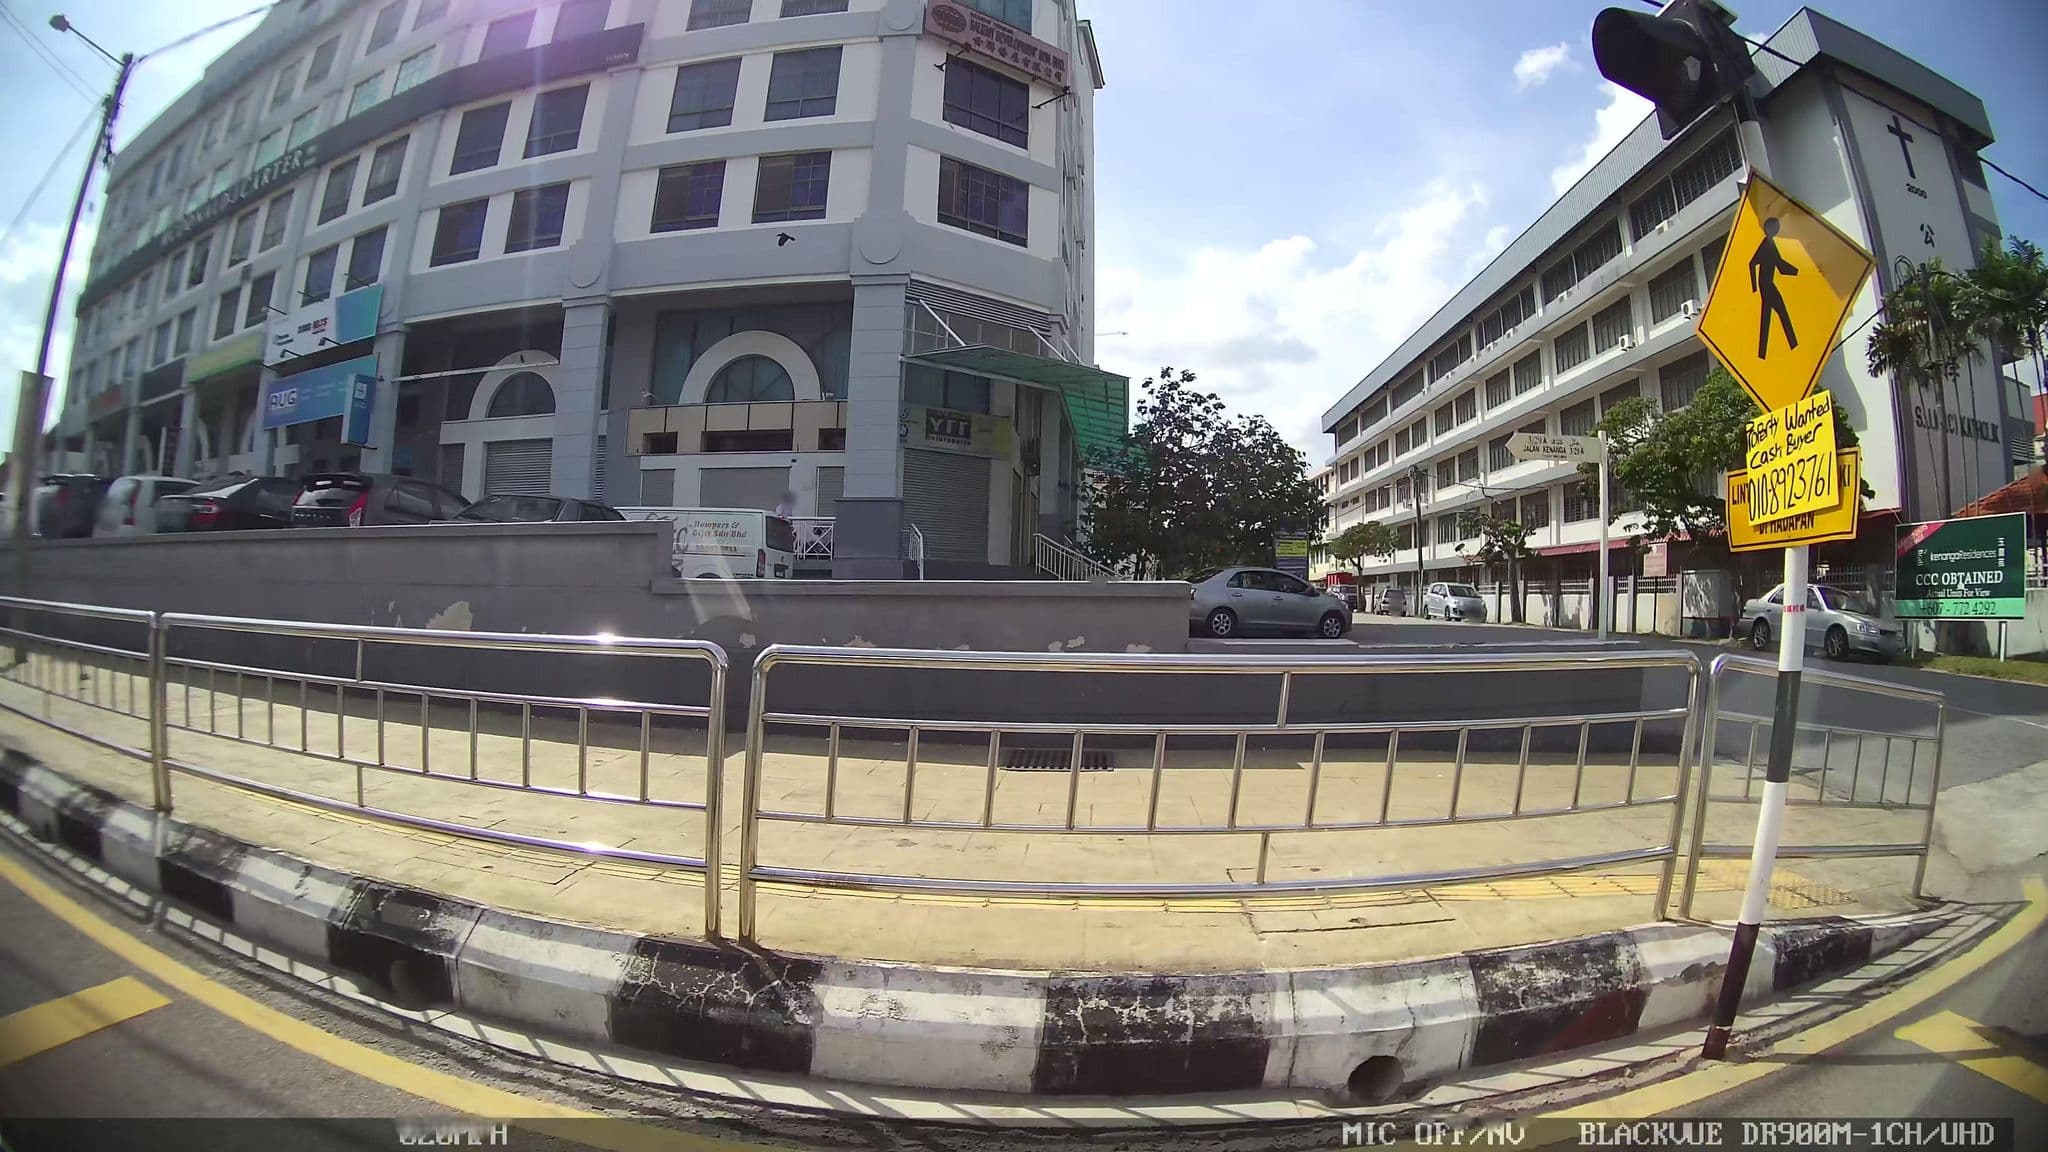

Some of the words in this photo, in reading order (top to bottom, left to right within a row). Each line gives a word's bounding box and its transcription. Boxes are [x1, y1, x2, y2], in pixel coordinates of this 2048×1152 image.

[1906, 183, 1928, 199] 2000
[1919, 223, 1936, 248] 公
[1785, 396, 1831, 431] Wanted
[1786, 423, 1822, 455] Buyer
[1523, 444, 1540, 452] JALAN
[713, 529, 729, 537] Sdn
[731, 530, 747, 538] Bhd
[1915, 573, 1939, 586] CCC
[1941, 570, 2004, 585] OBTAINED
[1953, 601, 1969, 615] 772
[1972, 601, 1996, 616] 4292
